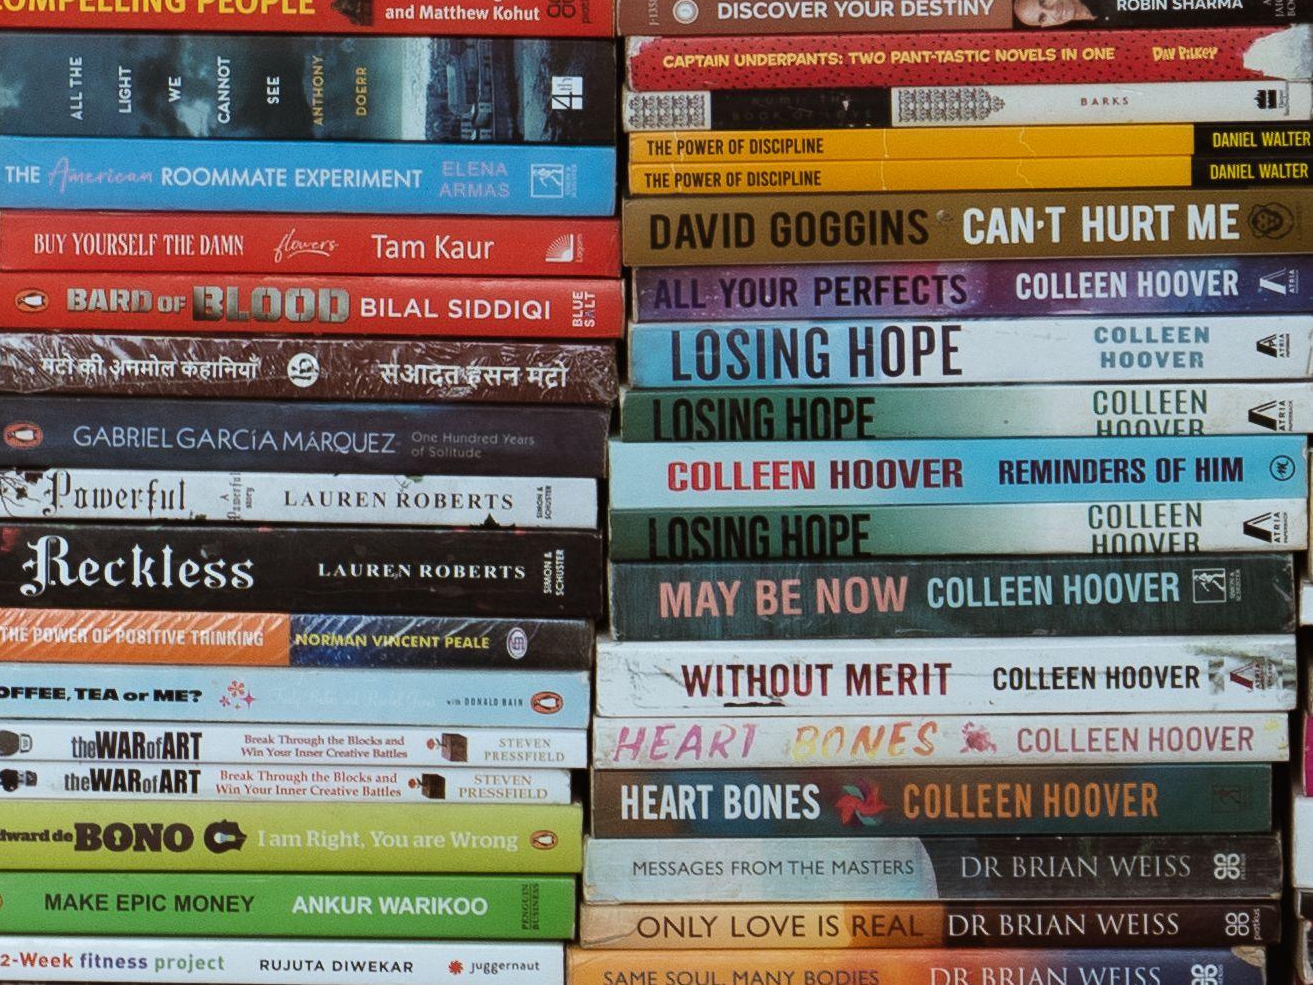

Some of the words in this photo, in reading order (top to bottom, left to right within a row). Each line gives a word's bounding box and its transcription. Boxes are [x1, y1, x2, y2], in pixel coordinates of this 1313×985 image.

[384, 4, 414, 22] and
[419, 4, 488, 22] Matthew
[492, 4, 540, 22] Kohut
[1079, 95, 1130, 107] BARKS
[1212, 131, 1257, 149] DANIEL
[1260, 130, 1311, 148] WALTER
[359, 296, 440, 320] BILAL
[447, 298, 551, 323] SIDDIQI
[1093, 324, 1210, 346] COLLEEN
[1100, 348, 1205, 370] HOOVER
[632, 858, 725, 878] MESSAGES
[730, 858, 784, 877] FROM
[788, 858, 824, 876] THE
[831, 857, 915, 877] MASTERS
[259, 957, 327, 973] RUJUTA
[331, 959, 414, 974] DIWEKAR
[469, 958, 540, 974] juggernaut
